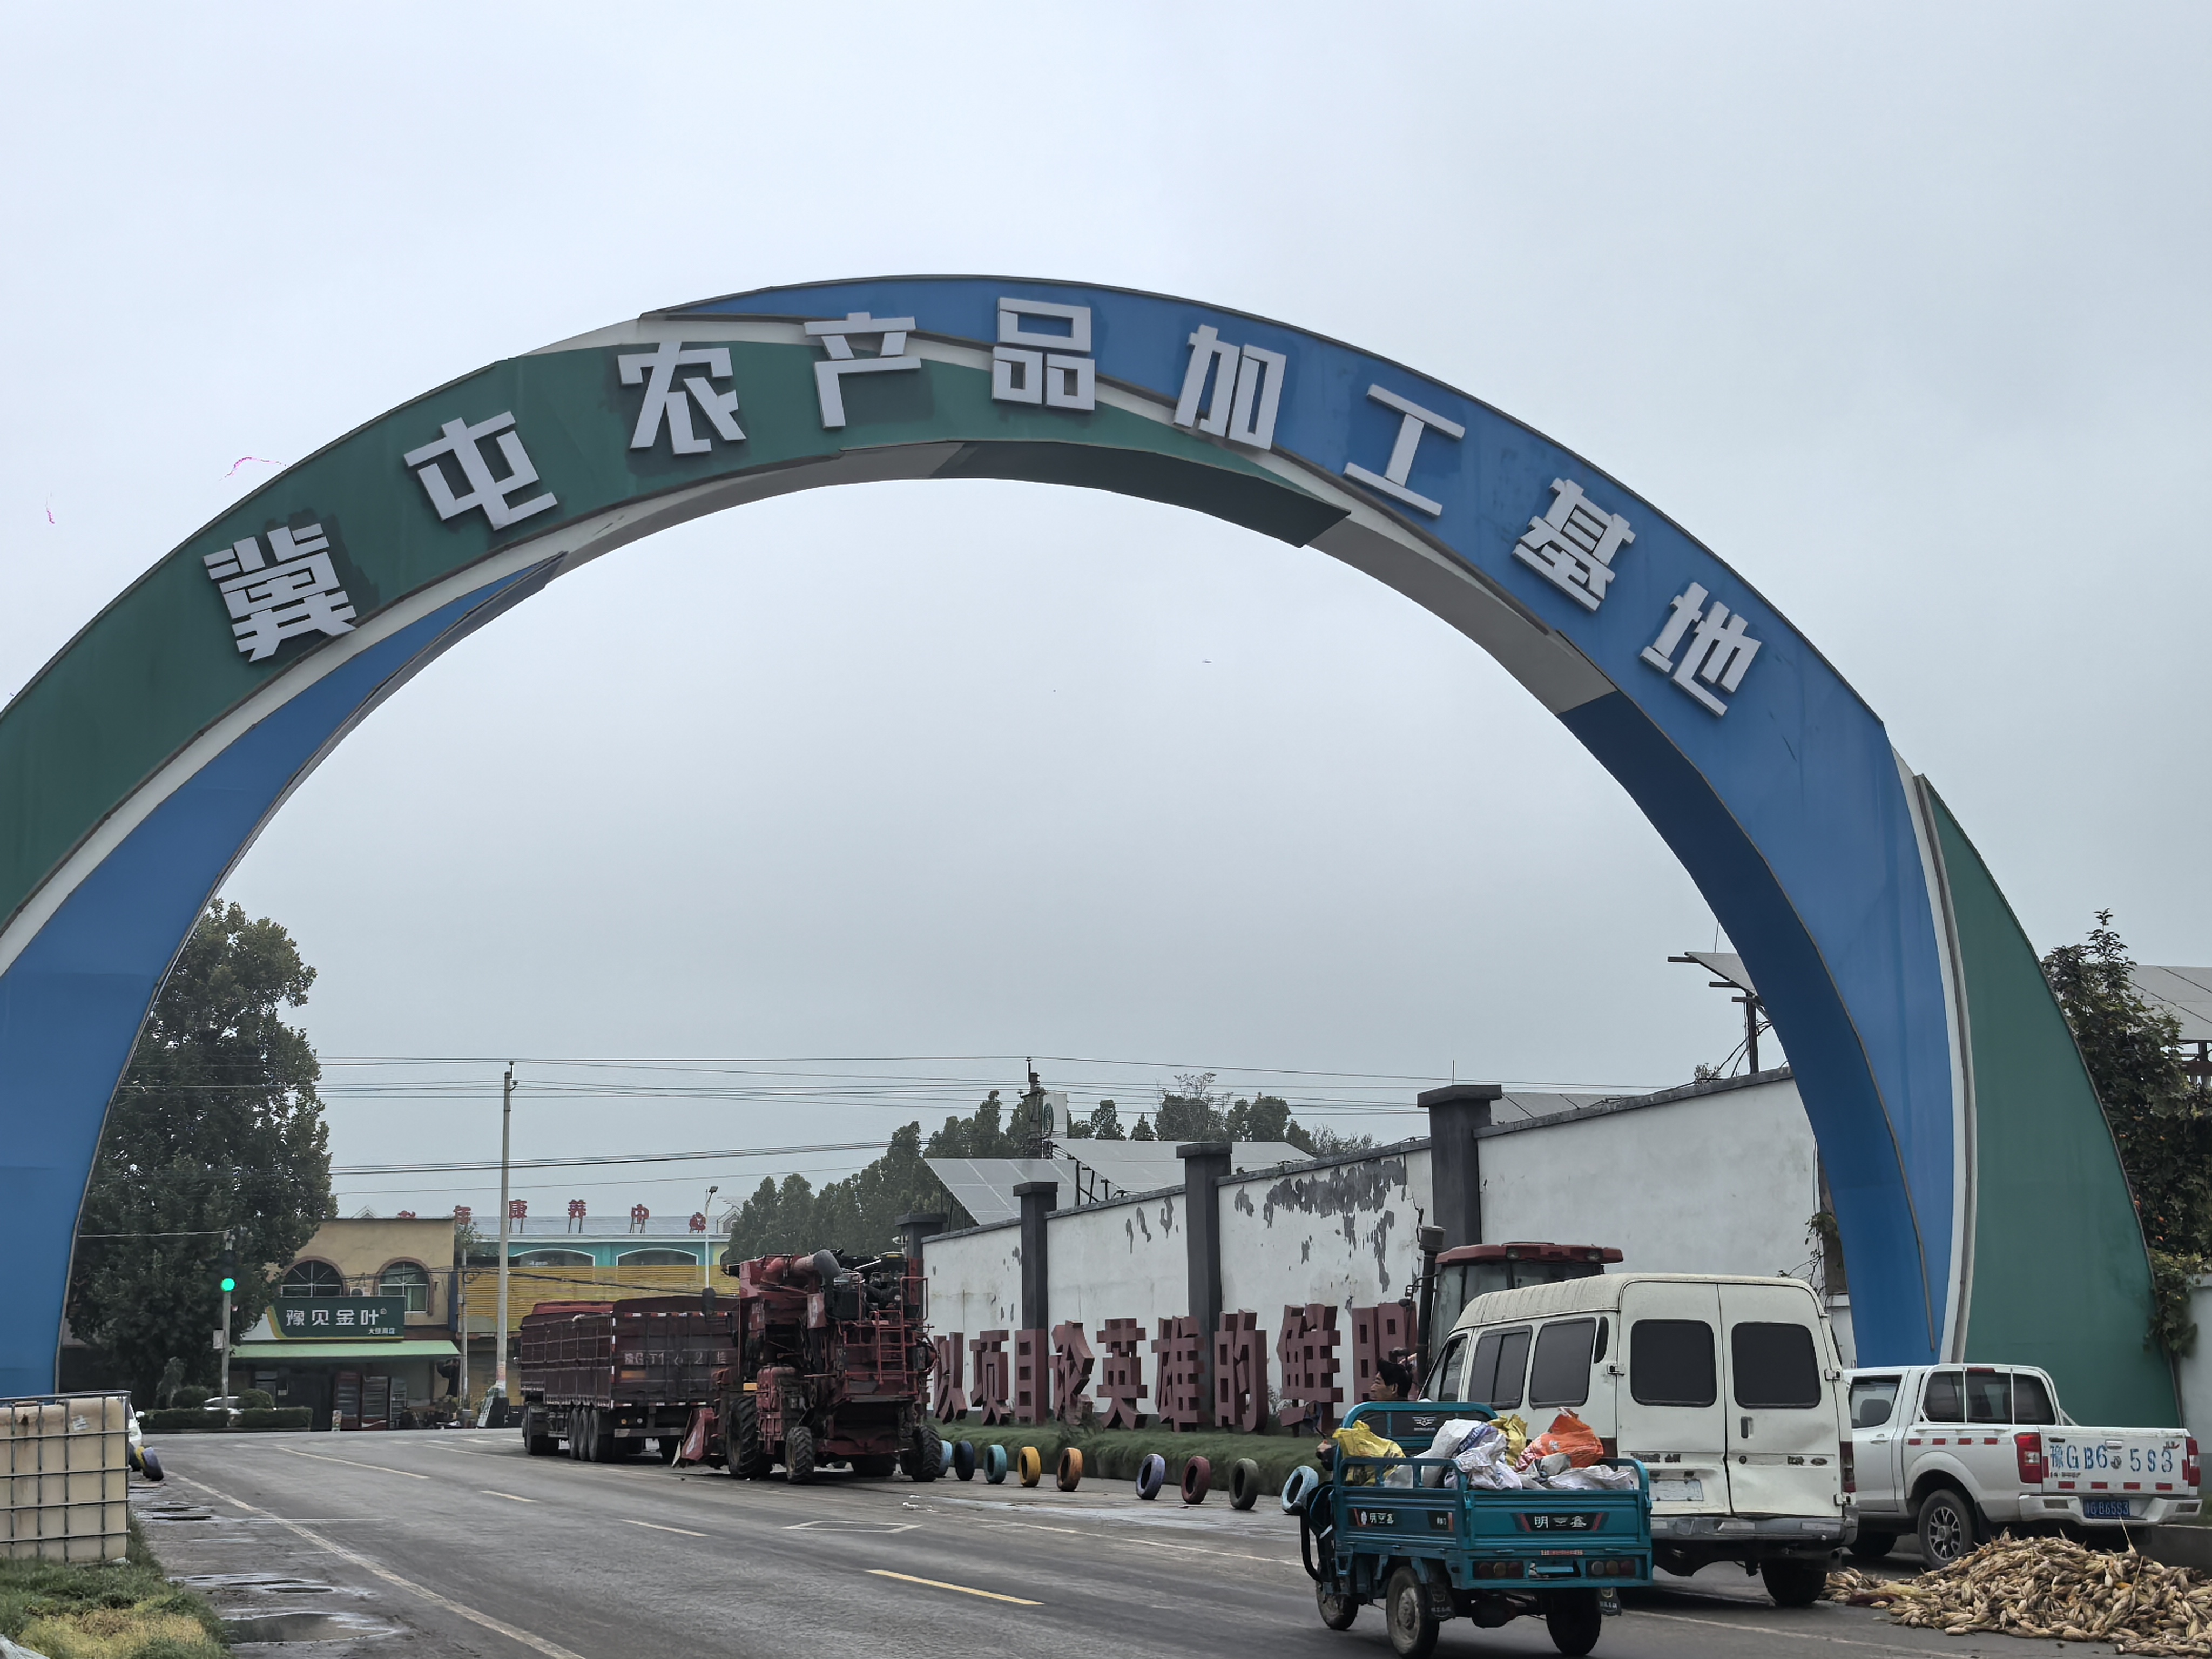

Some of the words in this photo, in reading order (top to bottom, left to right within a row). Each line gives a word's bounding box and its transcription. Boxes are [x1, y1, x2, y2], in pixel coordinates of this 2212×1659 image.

[203, 296, 1762, 717] 冀屯农产品加工基地
[286, 1309, 379, 1326] 豫见金叶
[1534, 1516, 1548, 1528] 明
